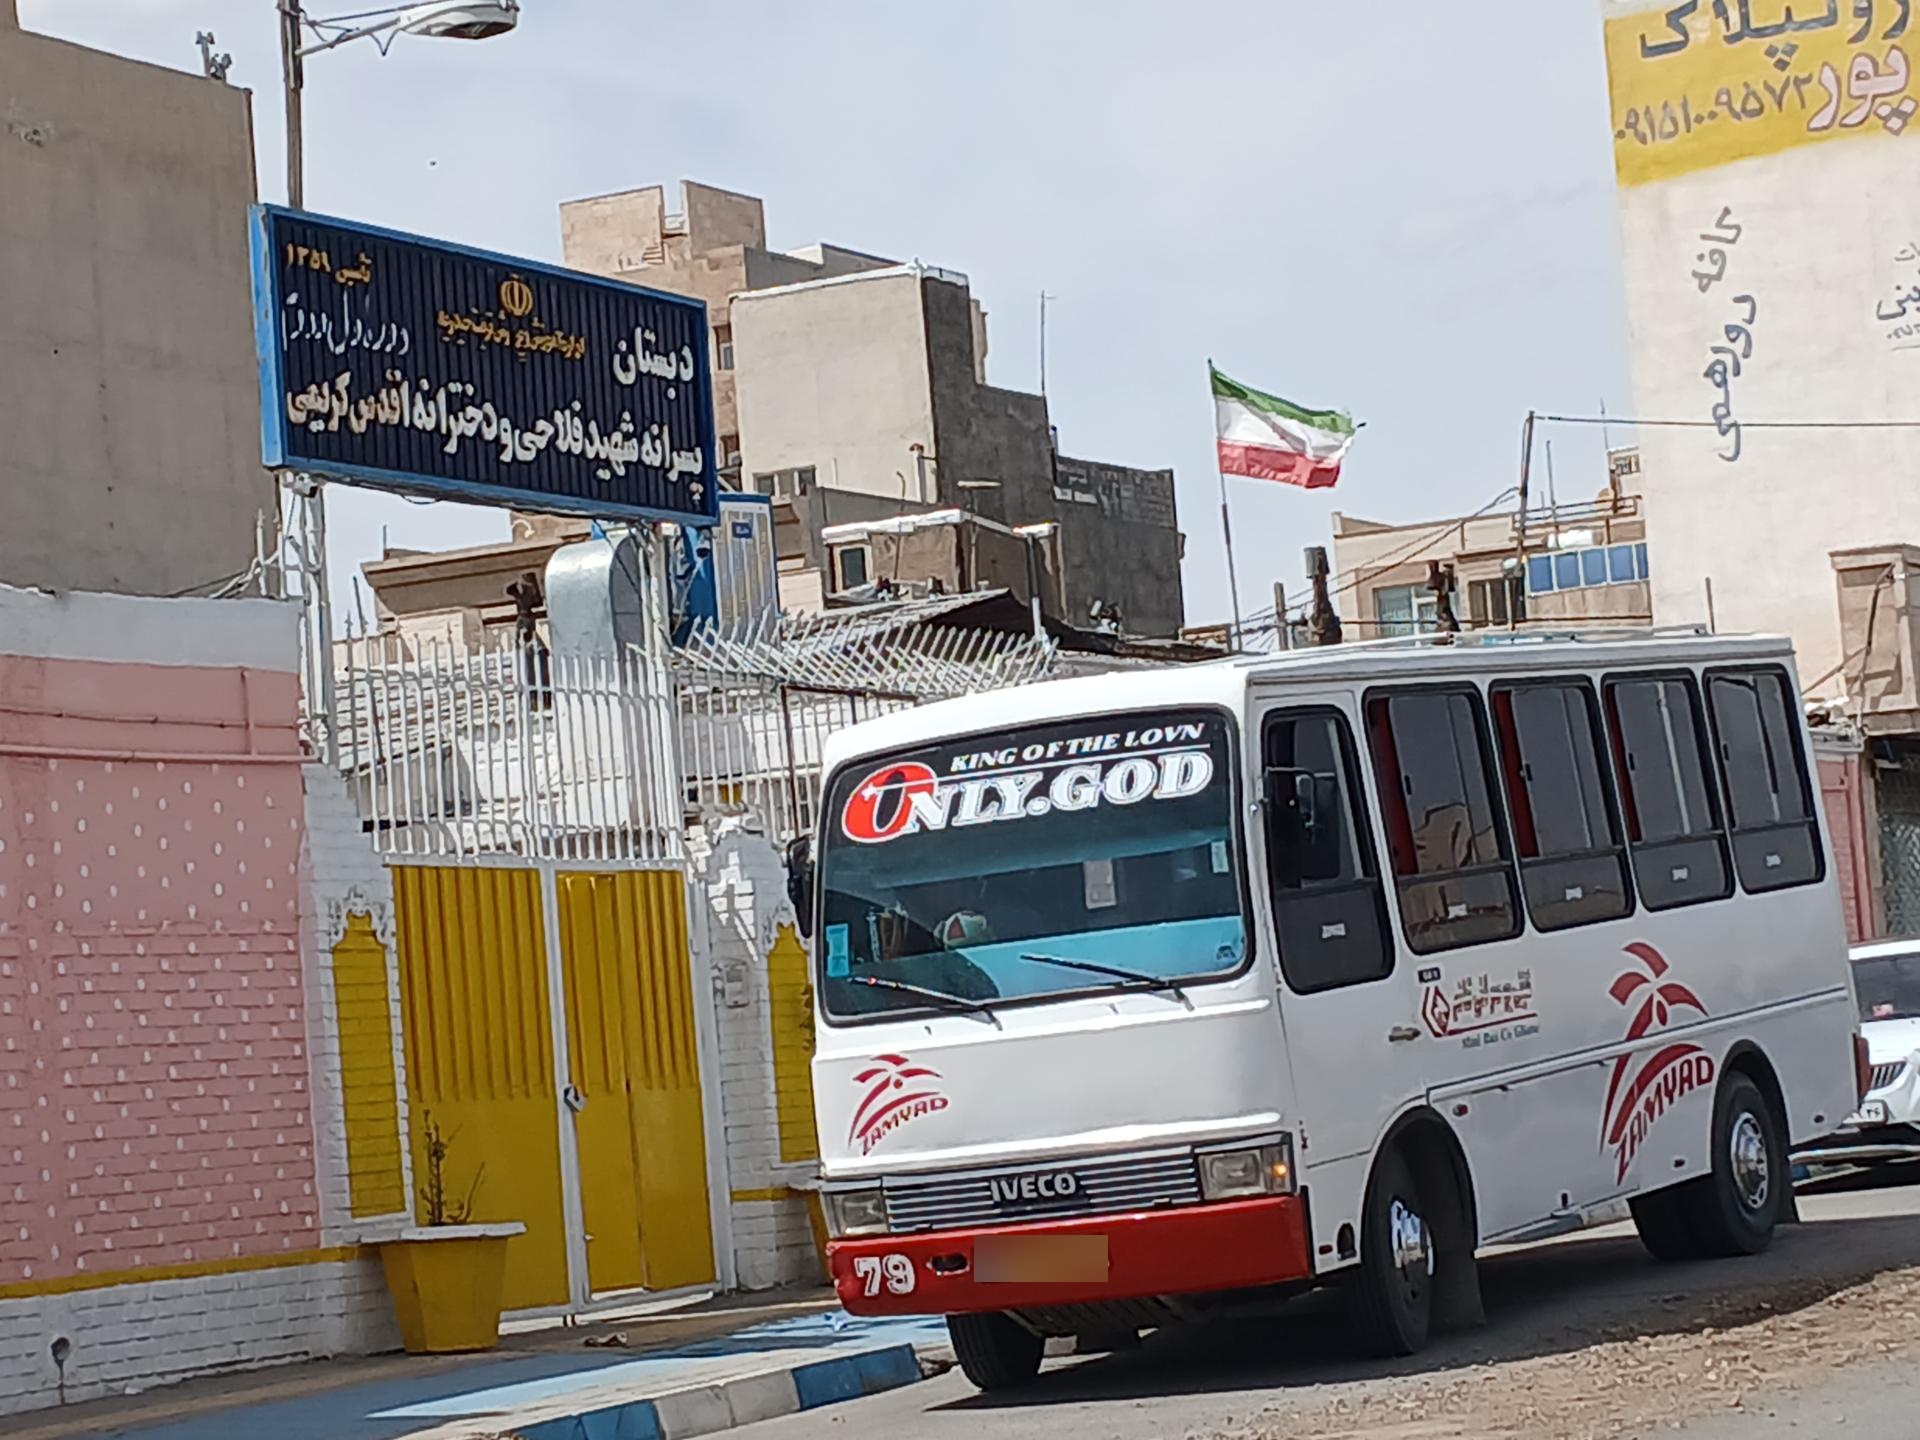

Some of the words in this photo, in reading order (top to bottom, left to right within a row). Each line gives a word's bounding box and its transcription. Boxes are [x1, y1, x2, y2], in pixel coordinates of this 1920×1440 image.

[1807, 44, 1919, 136] پور
[1691, 206, 1742, 293] کافه
[613, 326, 694, 399] دبستان
[286, 371, 351, 433] کریمی
[350, 368, 410, 433] اقدس
[412, 378, 498, 454] دخترانه
[514, 400, 584, 462] فلاحی
[499, 417, 513, 463] و
[584, 410, 639, 481] شهید
[641, 423, 704, 500] پسرانه
[950, 747, 1018, 772] KING
[1022, 741, 1063, 761] OF
[1065, 733, 1121, 756] THE
[1124, 722, 1206, 748] LOVN
[861, 1096, 950, 1157] ZAMYAD
[1614, 1055, 1715, 1187] ZAMYAD
[990, 1171, 1077, 1203] IVECO
[853, 1253, 916, 1298] 79
